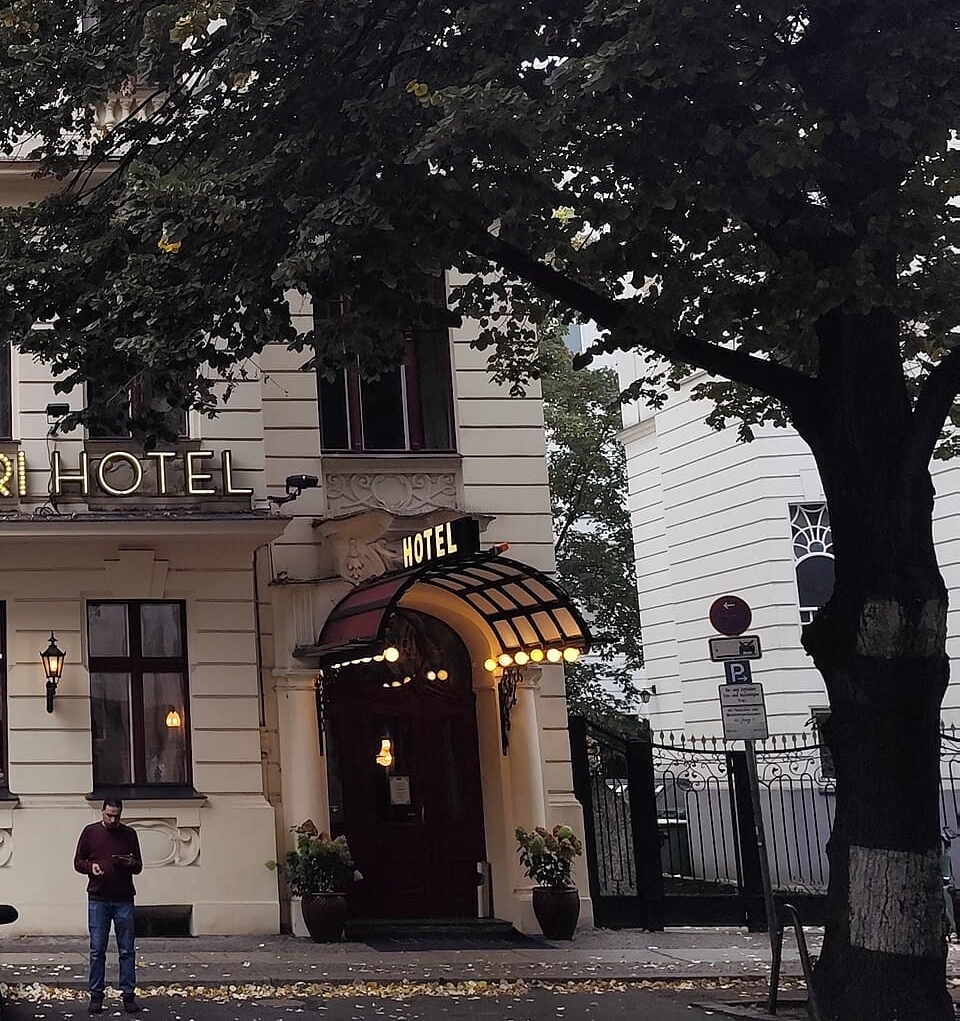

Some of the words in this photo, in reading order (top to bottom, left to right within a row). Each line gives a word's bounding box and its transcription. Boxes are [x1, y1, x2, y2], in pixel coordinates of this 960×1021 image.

[53, 449, 253, 496] HOTEL
[403, 521, 458, 568] HOTEL
[730, 663, 745, 682] P
